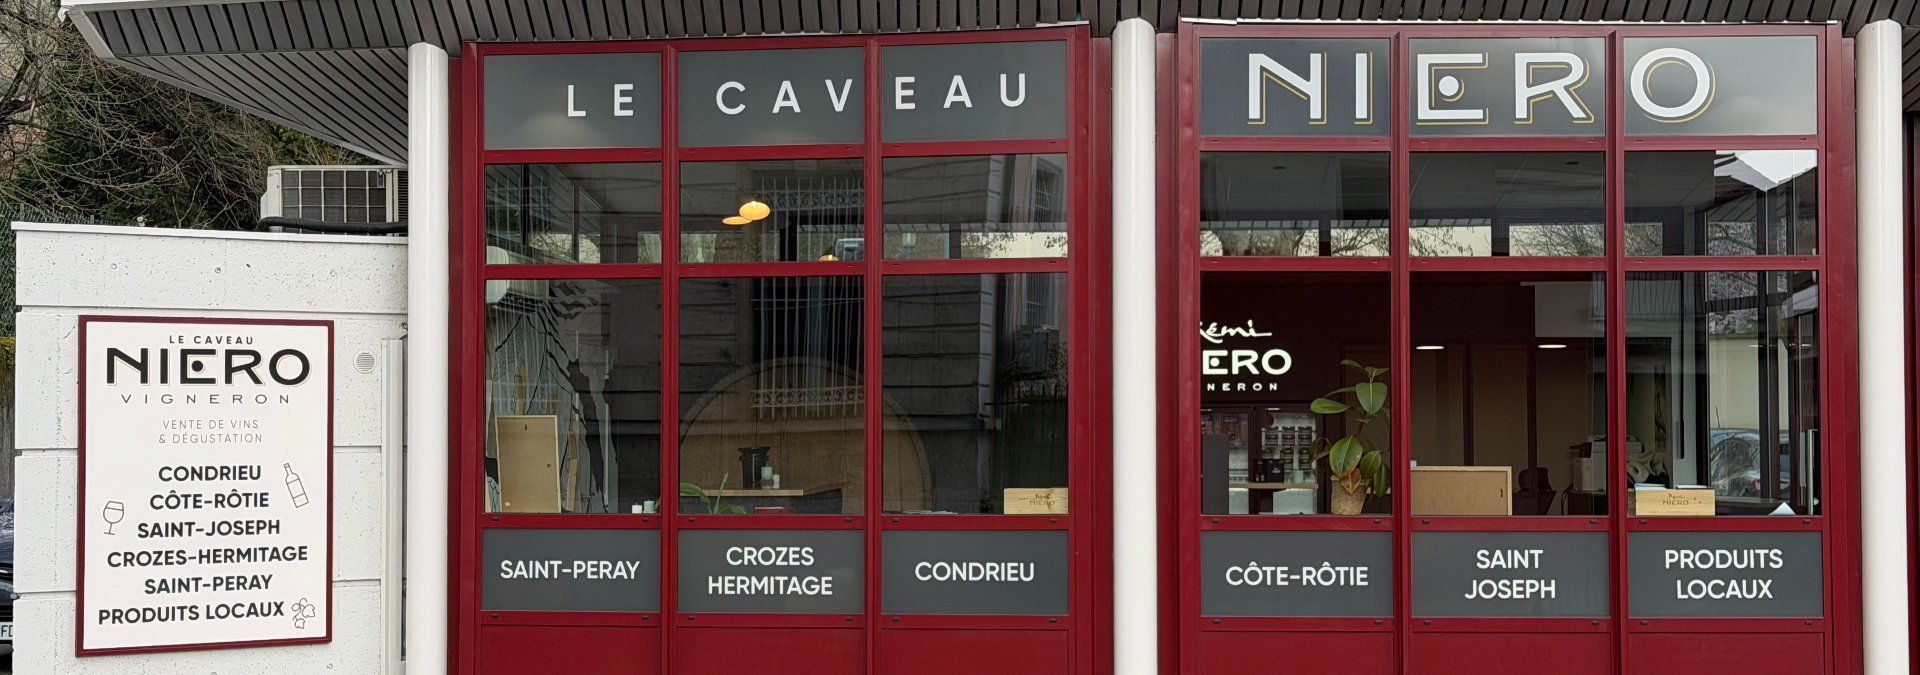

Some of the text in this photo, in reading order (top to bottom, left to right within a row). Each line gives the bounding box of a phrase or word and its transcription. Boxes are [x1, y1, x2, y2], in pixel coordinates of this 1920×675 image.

[567, 73, 1027, 118] LE CAVEAU
[1246, 47, 1716, 125] NIERO
[169, 334, 254, 346] LE CAVEAU
[106, 347, 311, 386] NIERO
[1202, 348, 1292, 376] ERO
[1206, 382, 1279, 392] NERON
[120, 393, 291, 405] VIGNERON
[162, 418, 260, 430] VENTE DE VINS
[158, 431, 263, 444] & DÉGUSTATION
[158, 464, 262, 483] CONDRIEU
[149, 488, 270, 511] CÔTE-RÔTIE
[137, 519, 281, 539] SAINT-JOSEPH
[106, 545, 309, 568] CROZES-HERMITAGE
[726, 546, 815, 567] CROZES
[1476, 549, 1544, 570] SAINT
[1664, 548, 1784, 569] PRODUITS
[500, 559, 641, 580] SAINT-PERAY
[914, 561, 1036, 582] CONDRIEU
[1225, 561, 1369, 587] CÔTE-RÔTIE
[144, 573, 274, 595] SAINT-PERAY
[708, 575, 834, 596] HERMITAGE
[1464, 579, 1556, 600] JOSEPH
[1676, 579, 1774, 600] LOCAUX
[98, 600, 285, 626] PRODUITS LOCAUX
